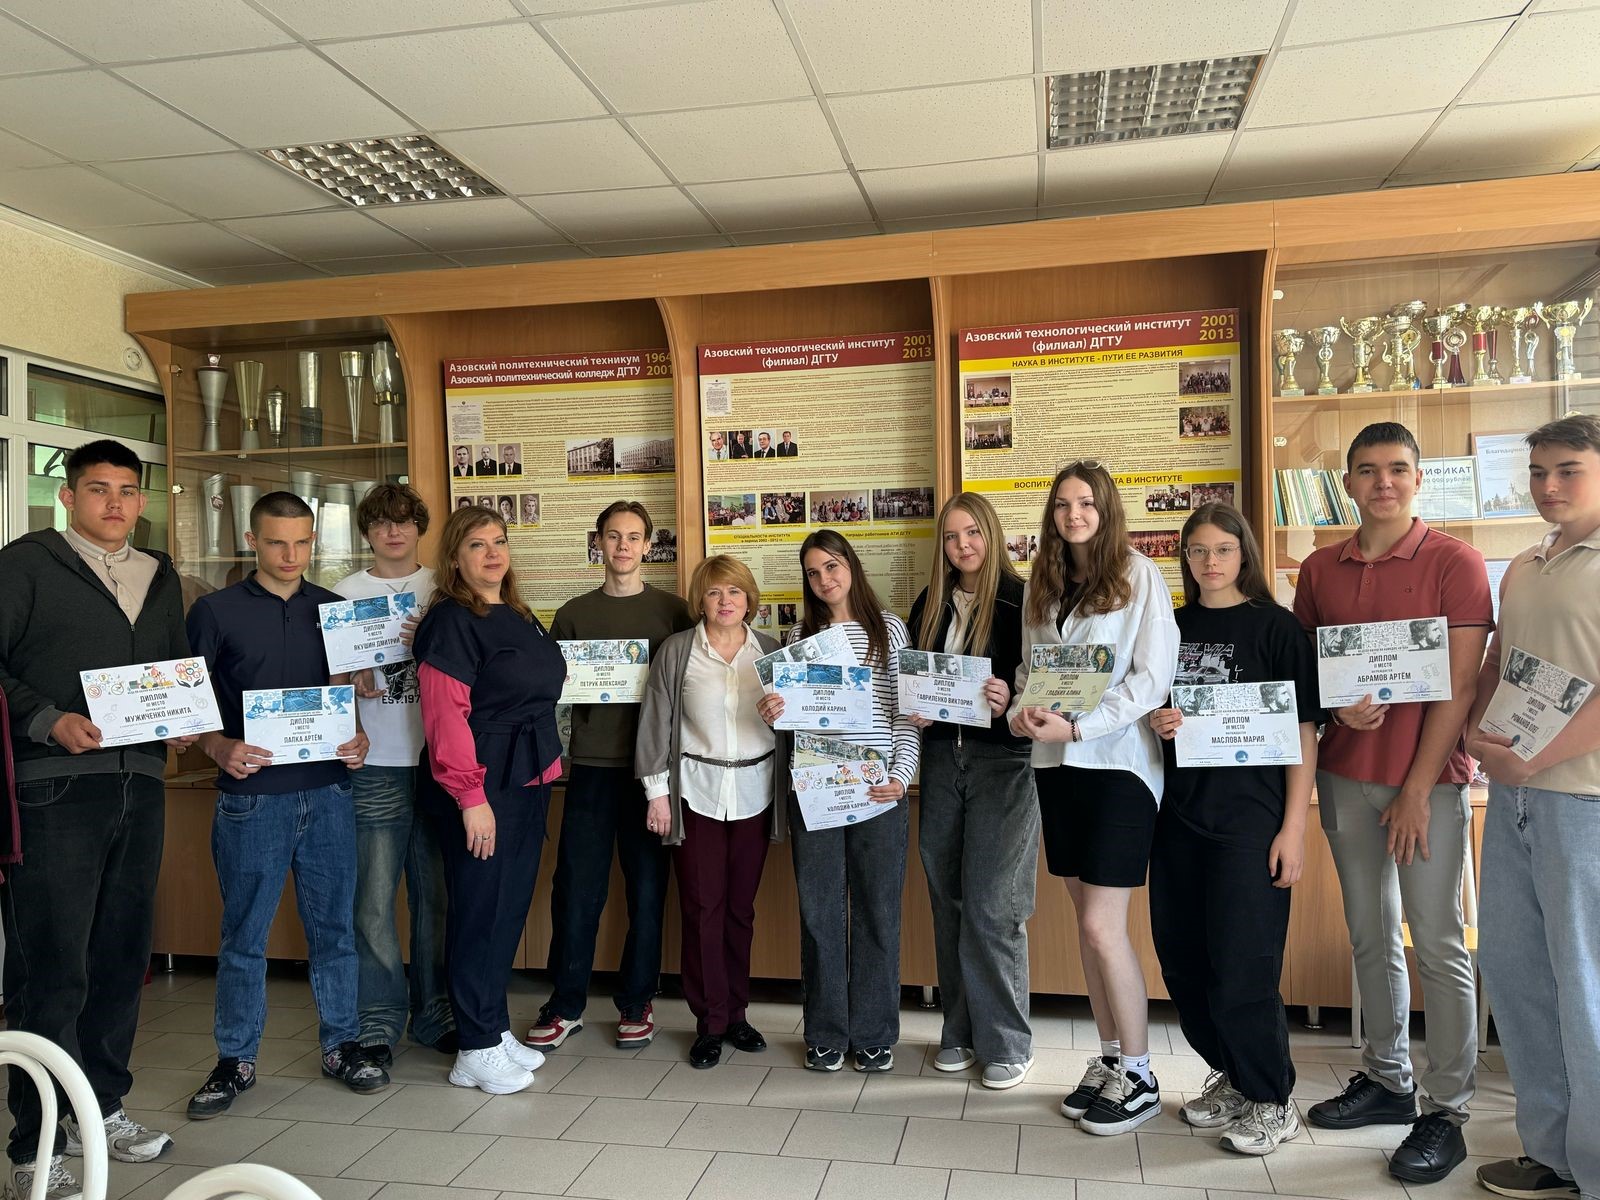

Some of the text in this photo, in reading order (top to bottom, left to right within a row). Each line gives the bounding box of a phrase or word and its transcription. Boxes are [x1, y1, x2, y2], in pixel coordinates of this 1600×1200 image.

[1201, 314, 1235, 328] 2001
[965, 318, 1192, 343] Азовский технологический институт
[1199, 328, 1234, 342] 2013
[903, 334, 932, 347] 2001
[1032, 335, 1123, 353] (филиал) ДГТУ
[704, 338, 896, 358] Азовский технологический институт
[902, 347, 932, 359] 2013
[449, 354, 640, 373] Азовский политехнический техникум
[645, 352, 672, 364] 1964
[762, 353, 839, 369] (филиал) ДГТУ
[1012, 359, 1039, 368] НАУКА
[1048, 355, 1096, 366] ИНСТИТУТЕ
[1102, 353, 1124, 363] ПУТИ
[1138, 349, 1184, 359] РАЗВИТИЯ
[450, 365, 641, 385] Азовский политехнический колледж ДГТУ
[646, 364, 673, 377] 2001
[1134, 474, 1183, 483] ИНСТИТУТЕ
[1368, 654, 1398, 663] ДИПЛОМ
[1357, 673, 1388, 683] АБРАМОВ
[139, 692, 168, 703] ДИПЛОМ
[916, 693, 973, 706] ГАВРИЛЕНКО ВИКТОРИЯ
[124, 706, 192, 723] МУЖИЧЕНКО НИКИТА
[801, 704, 827, 712] КОЛОДИЙ
[289, 717, 315, 726] ДИПЛОМ
[1222, 716, 1250, 724] ДИПЛОМ
[283, 736, 303, 744] ПАПКА
[1211, 735, 1265, 744] МАСЛОВА МАРИЯ
[851, 801, 871, 810] КАРИНА
